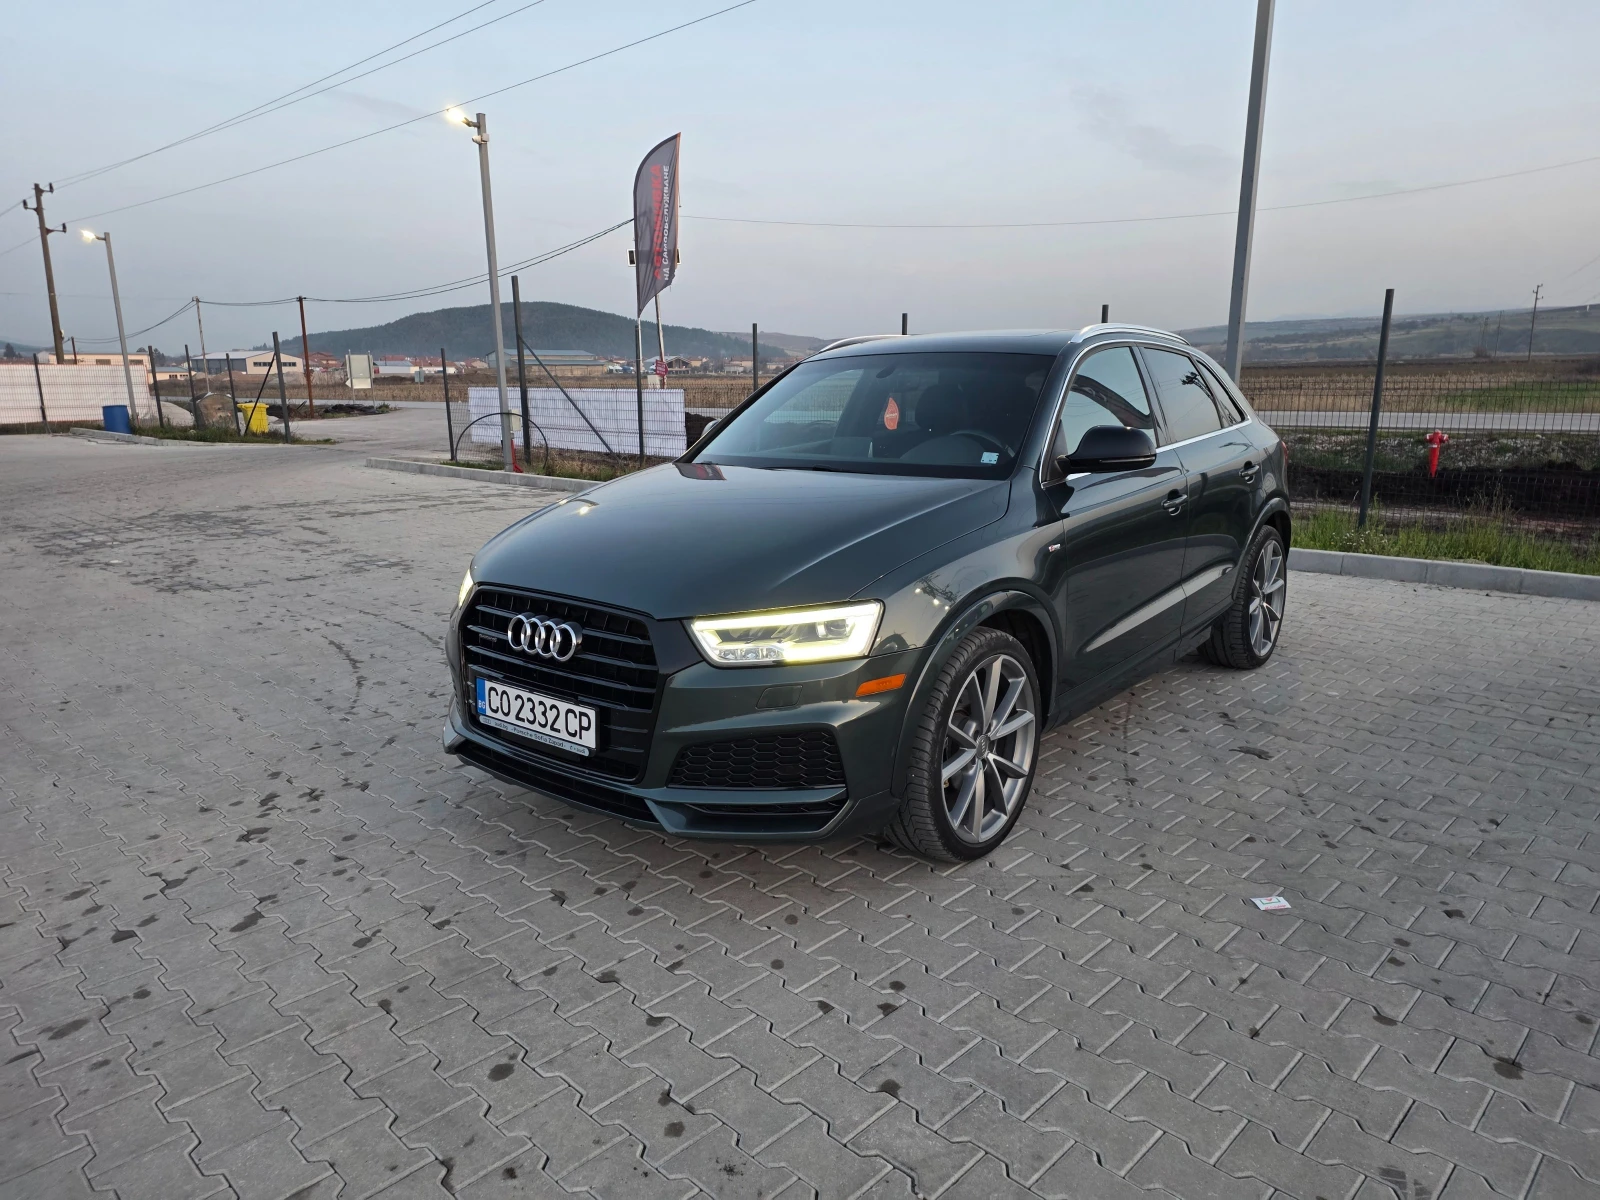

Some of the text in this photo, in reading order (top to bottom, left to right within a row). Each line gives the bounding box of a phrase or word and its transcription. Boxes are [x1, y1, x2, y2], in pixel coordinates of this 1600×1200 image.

[650, 164, 663, 280] АВТОМИВКА
[662, 267, 670, 281] НА
[478, 699, 486, 709] BG
[514, 694, 562, 733] 2332
